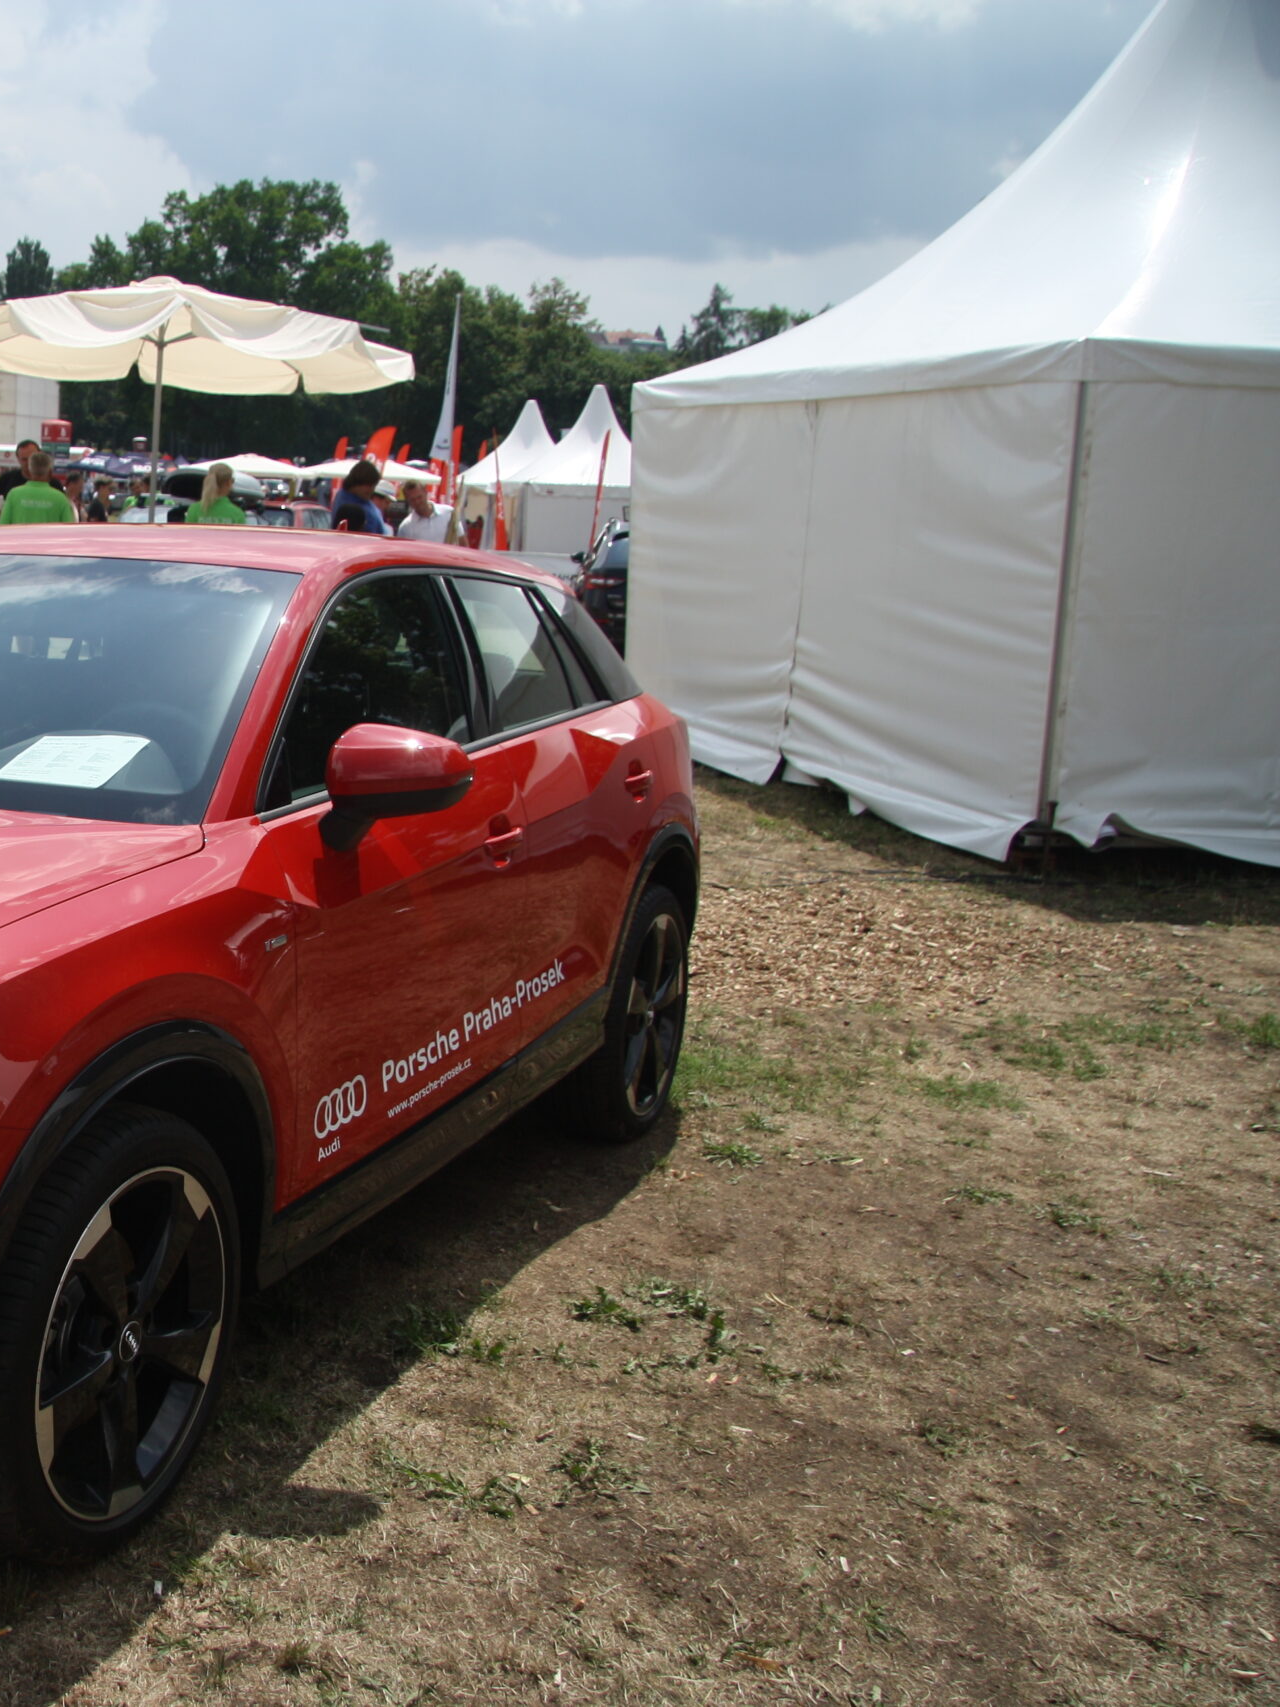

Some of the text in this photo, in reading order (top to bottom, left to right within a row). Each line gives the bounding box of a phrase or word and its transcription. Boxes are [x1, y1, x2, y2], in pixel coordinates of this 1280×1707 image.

[382, 958, 566, 1093] Porsche Praha-Prosek
[387, 1057, 472, 1118] www.porsche-prosek.cz
[318, 1136, 341, 1162] Audi
